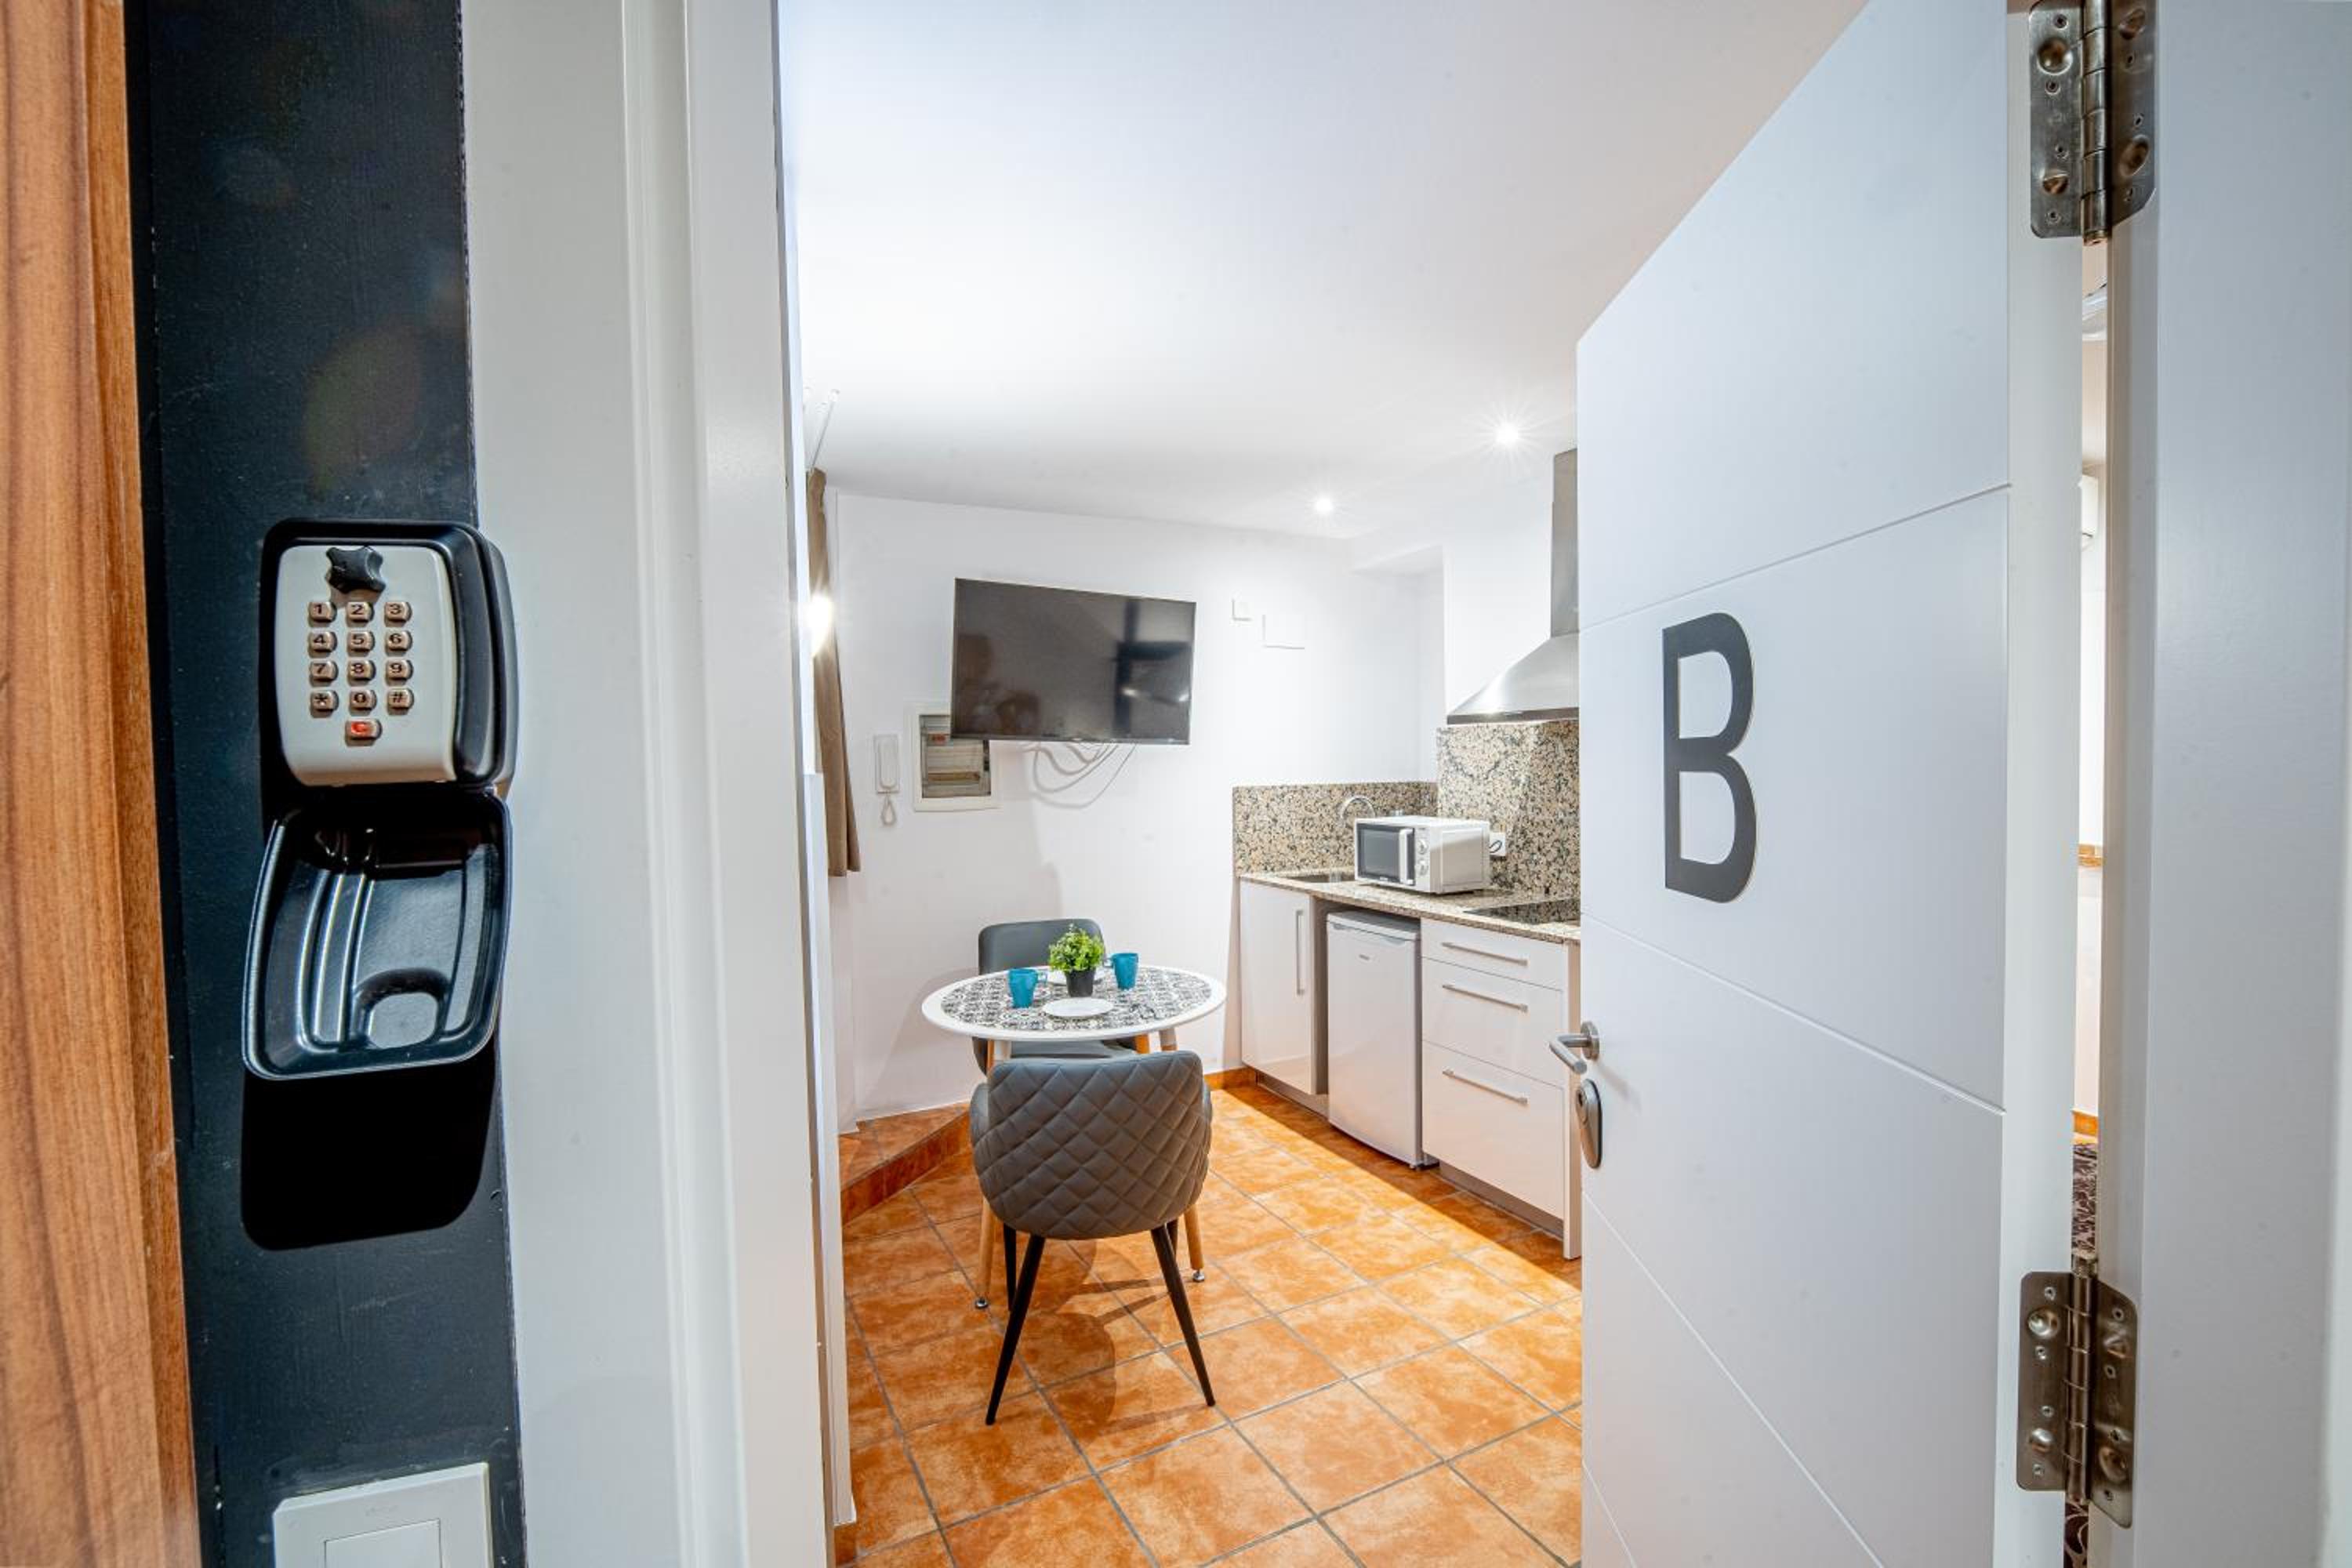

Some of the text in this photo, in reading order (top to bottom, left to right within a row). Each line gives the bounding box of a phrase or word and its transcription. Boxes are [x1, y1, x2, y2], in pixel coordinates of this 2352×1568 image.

[314, 603, 401, 615] 1 2 3
[314, 633, 401, 644] 4 5 6
[314, 662, 402, 673] 7 8 9
[354, 692, 366, 703] 0
[1662, 612, 1756, 903] B
